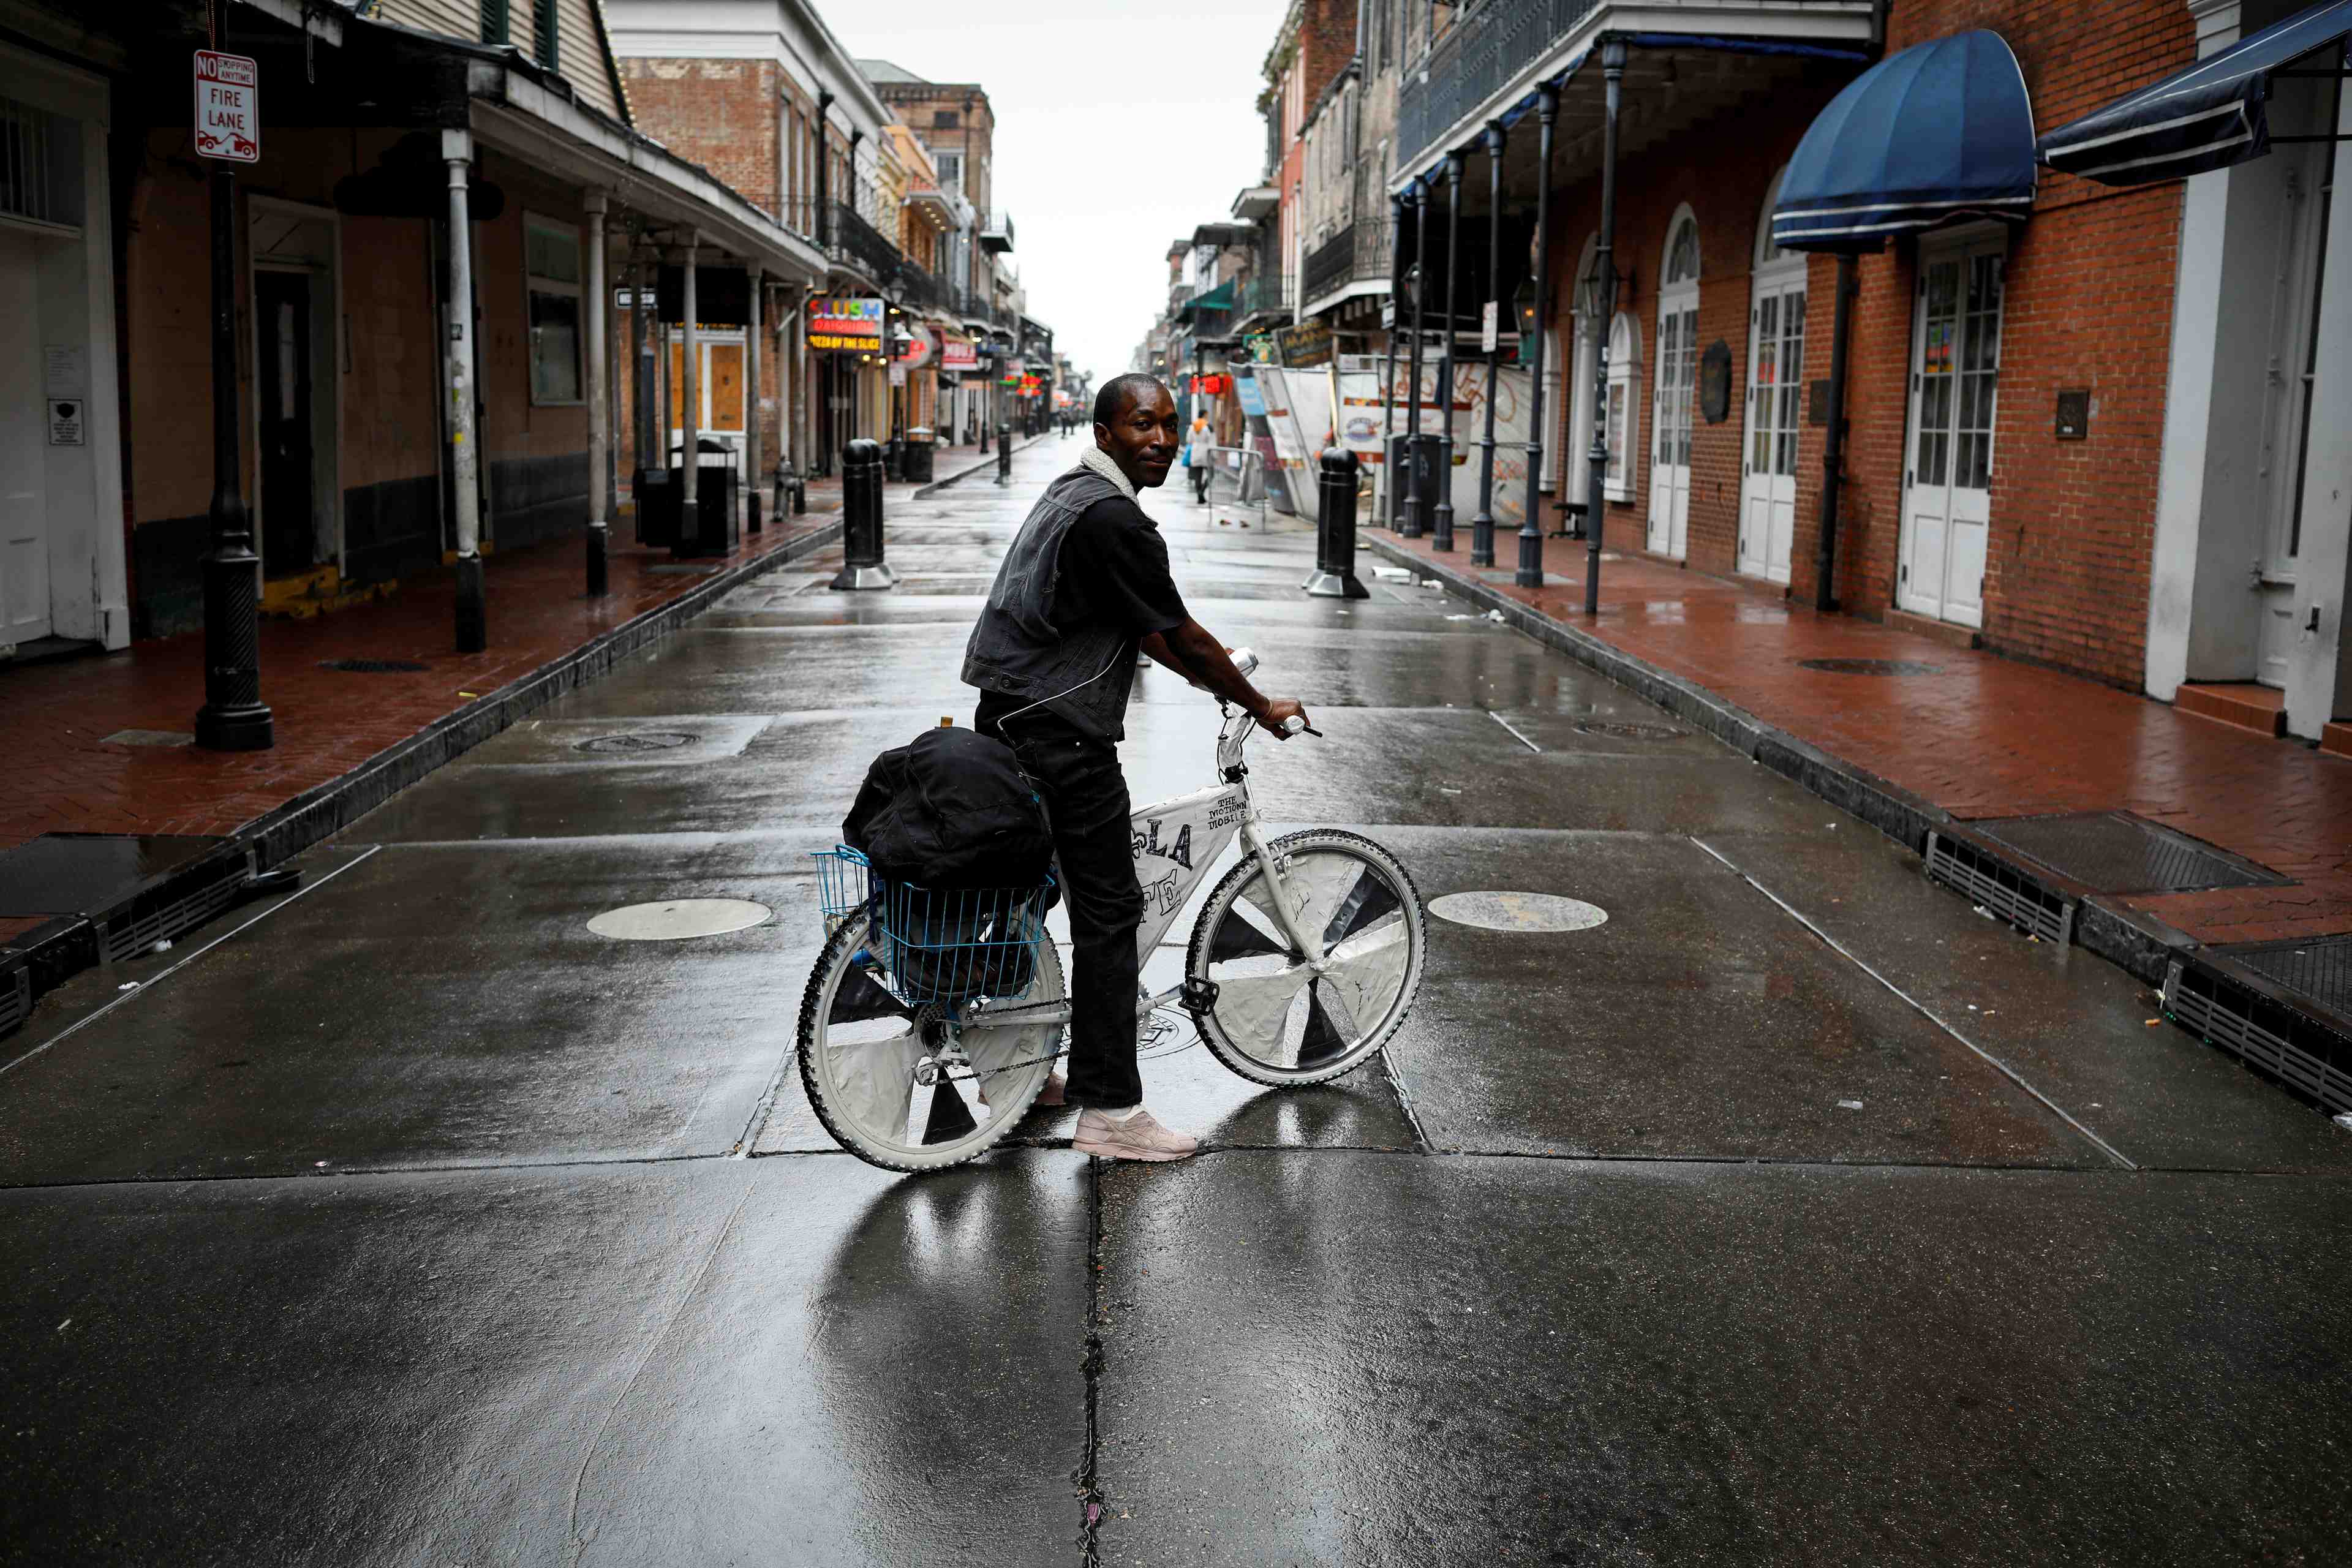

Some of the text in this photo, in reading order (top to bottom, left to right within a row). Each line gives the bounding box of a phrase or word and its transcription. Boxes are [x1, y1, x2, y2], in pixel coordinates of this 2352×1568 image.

[197, 56, 217, 77] NO
[217, 59, 253, 73] STOPPING
[221, 70, 251, 83] ANYTIME
[211, 88, 242, 107] FIRE
[209, 110, 245, 130] LANE
[809, 300, 880, 320] SLUSH
[843, 337, 857, 350] THE
[858, 338, 880, 351] SLICE
[1208, 801, 1246, 820] MOTIONN
[1218, 795, 1237, 807] THE
